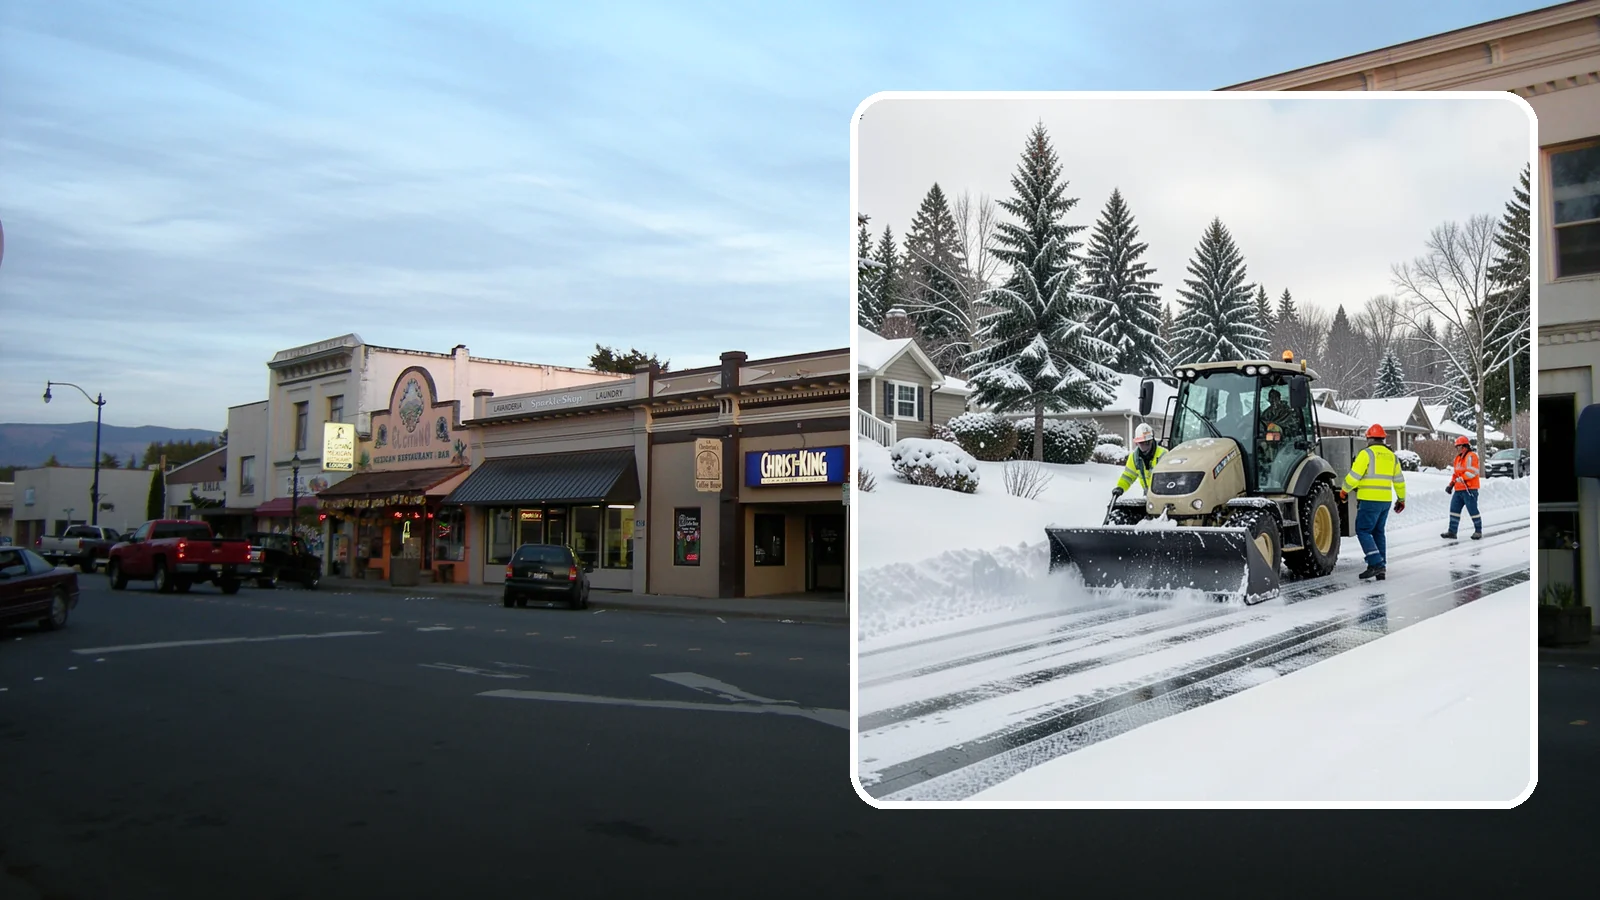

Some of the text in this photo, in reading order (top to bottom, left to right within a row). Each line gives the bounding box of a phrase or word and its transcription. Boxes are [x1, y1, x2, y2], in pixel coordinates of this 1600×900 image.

[595, 389, 624, 400] LAUNDRY
[531, 394, 583, 409] Sparkle Shop
[493, 402, 523, 413] LAVANDERIA
[397, 451, 433, 462] RESTAURANT
[438, 450, 450, 459] BAR
